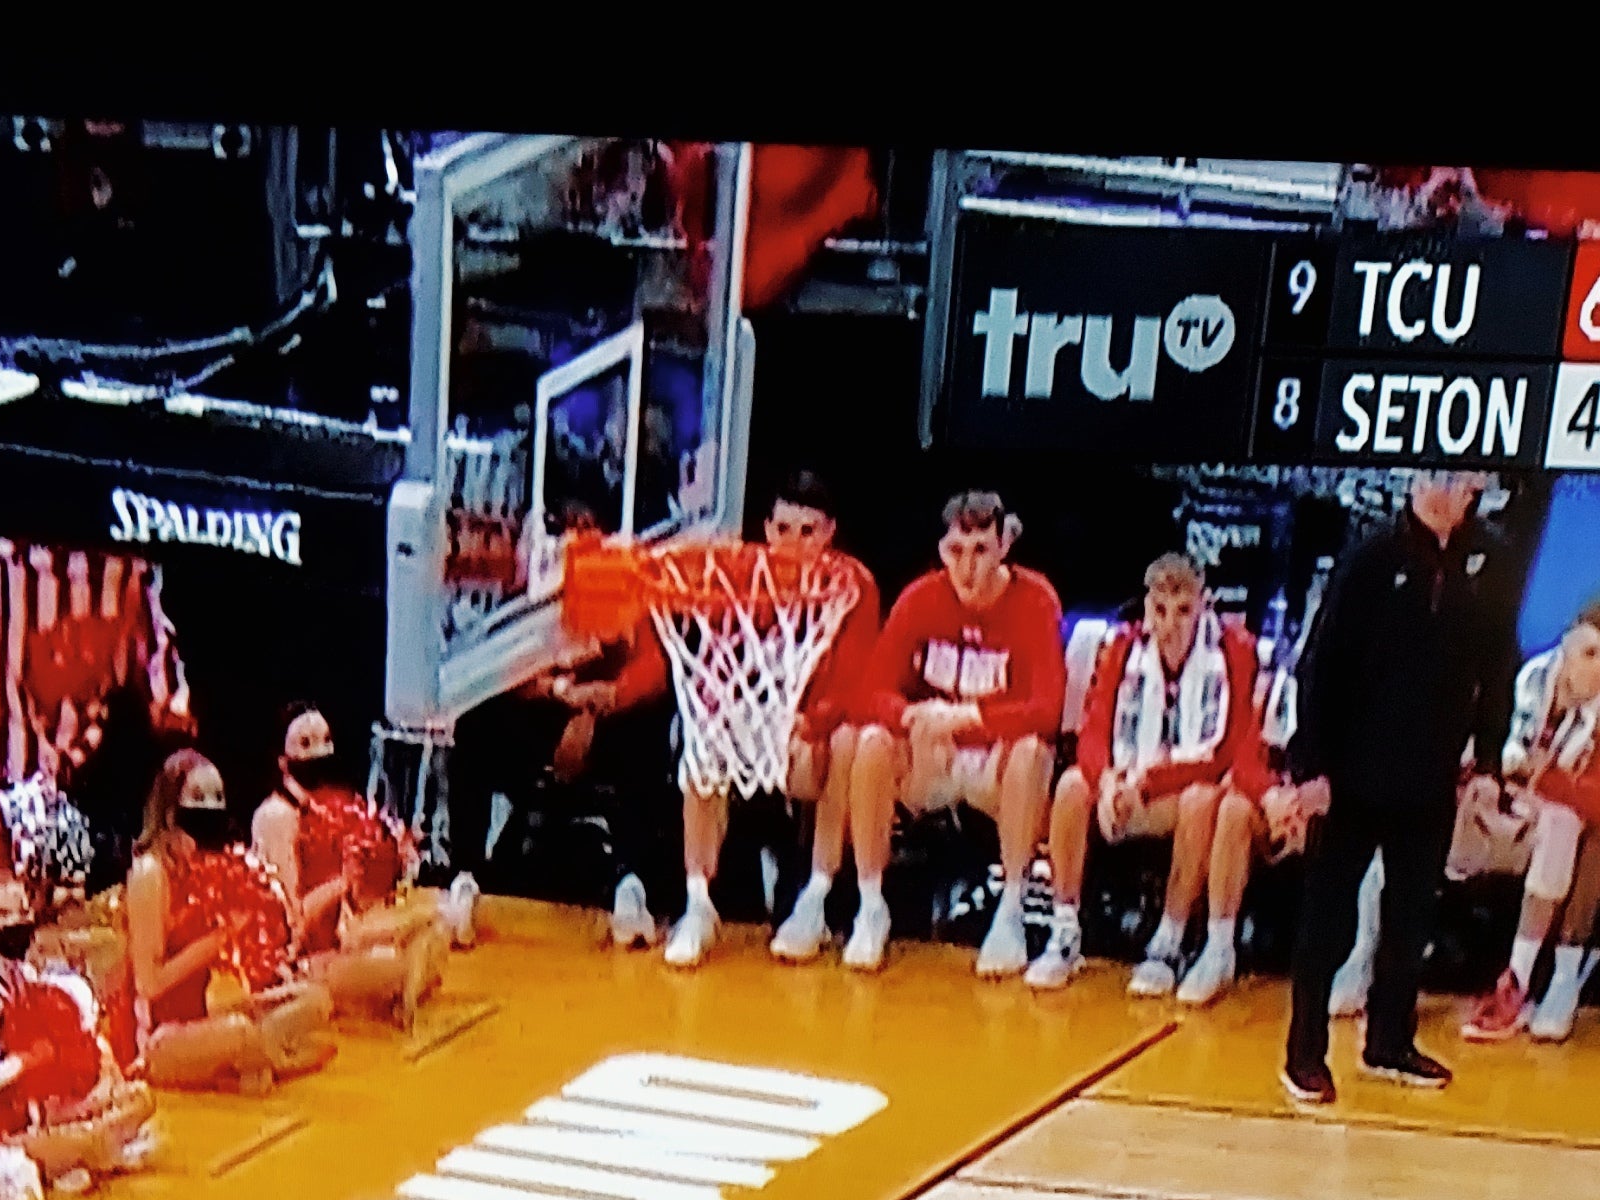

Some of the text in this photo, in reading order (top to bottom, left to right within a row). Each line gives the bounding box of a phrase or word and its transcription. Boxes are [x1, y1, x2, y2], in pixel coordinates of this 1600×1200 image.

[1289, 260, 1317, 315] 9
[1353, 257, 1481, 343] TCU
[1273, 377, 1301, 430] 8
[1335, 373, 1528, 456] SETON
[110, 487, 302, 566] SPALDING
